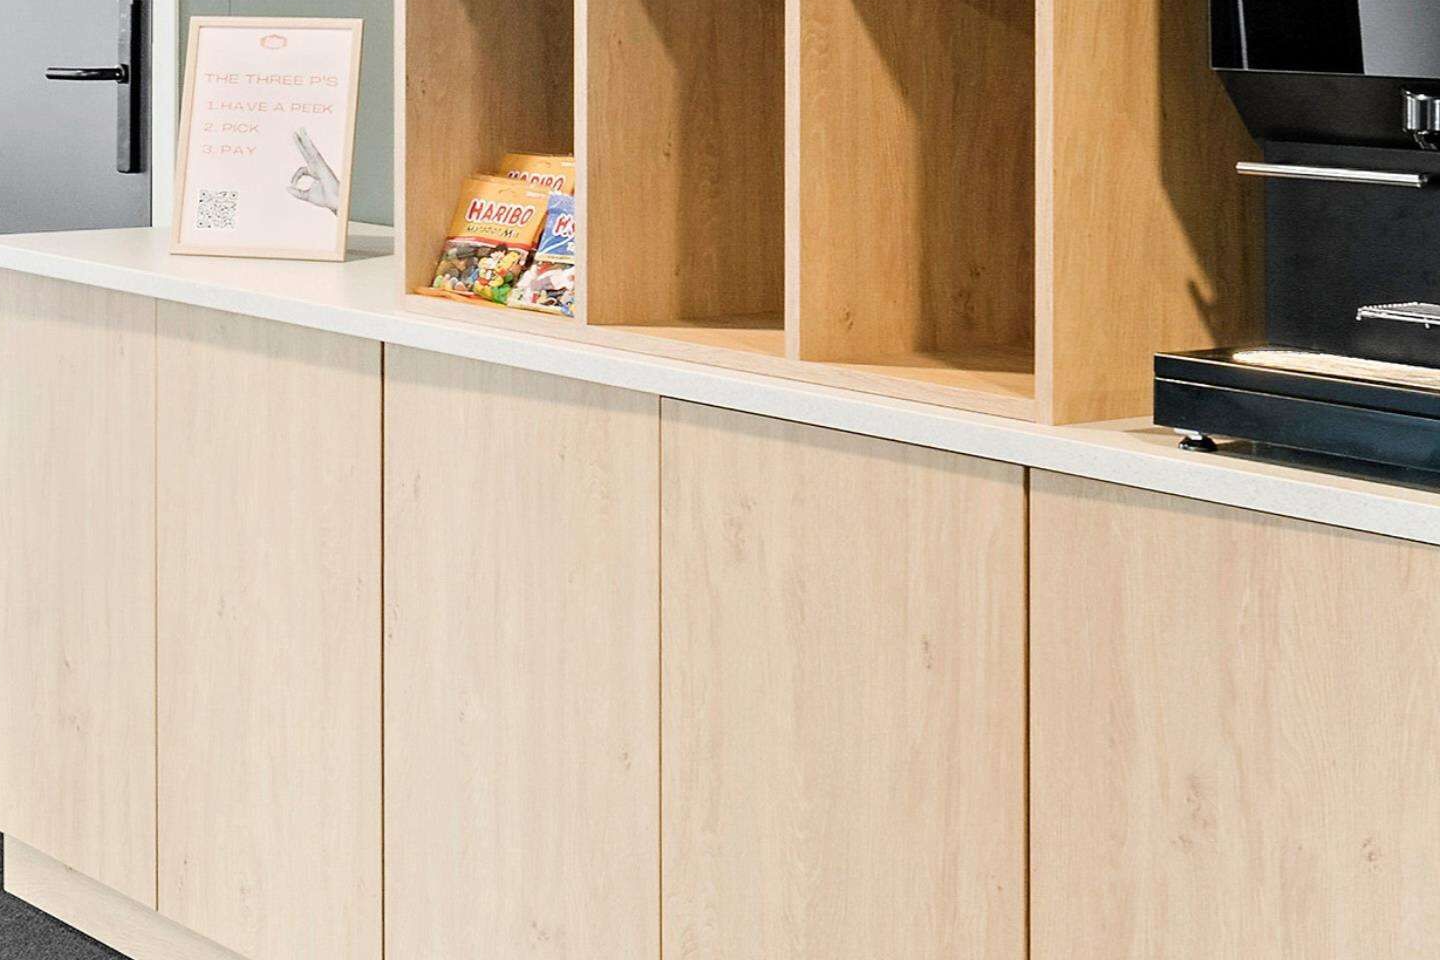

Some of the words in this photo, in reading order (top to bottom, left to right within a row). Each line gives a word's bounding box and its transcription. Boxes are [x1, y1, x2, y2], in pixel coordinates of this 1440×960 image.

[205, 73, 239, 85] THE
[246, 74, 304, 86] THREE
[310, 76, 338, 88] P'S
[220, 101, 268, 112] HAVE
[273, 102, 285, 112] A
[291, 103, 333, 114] PEEK
[222, 123, 259, 133] PICK
[221, 145, 257, 155] PAY
[467, 200, 535, 226] HARIBO
